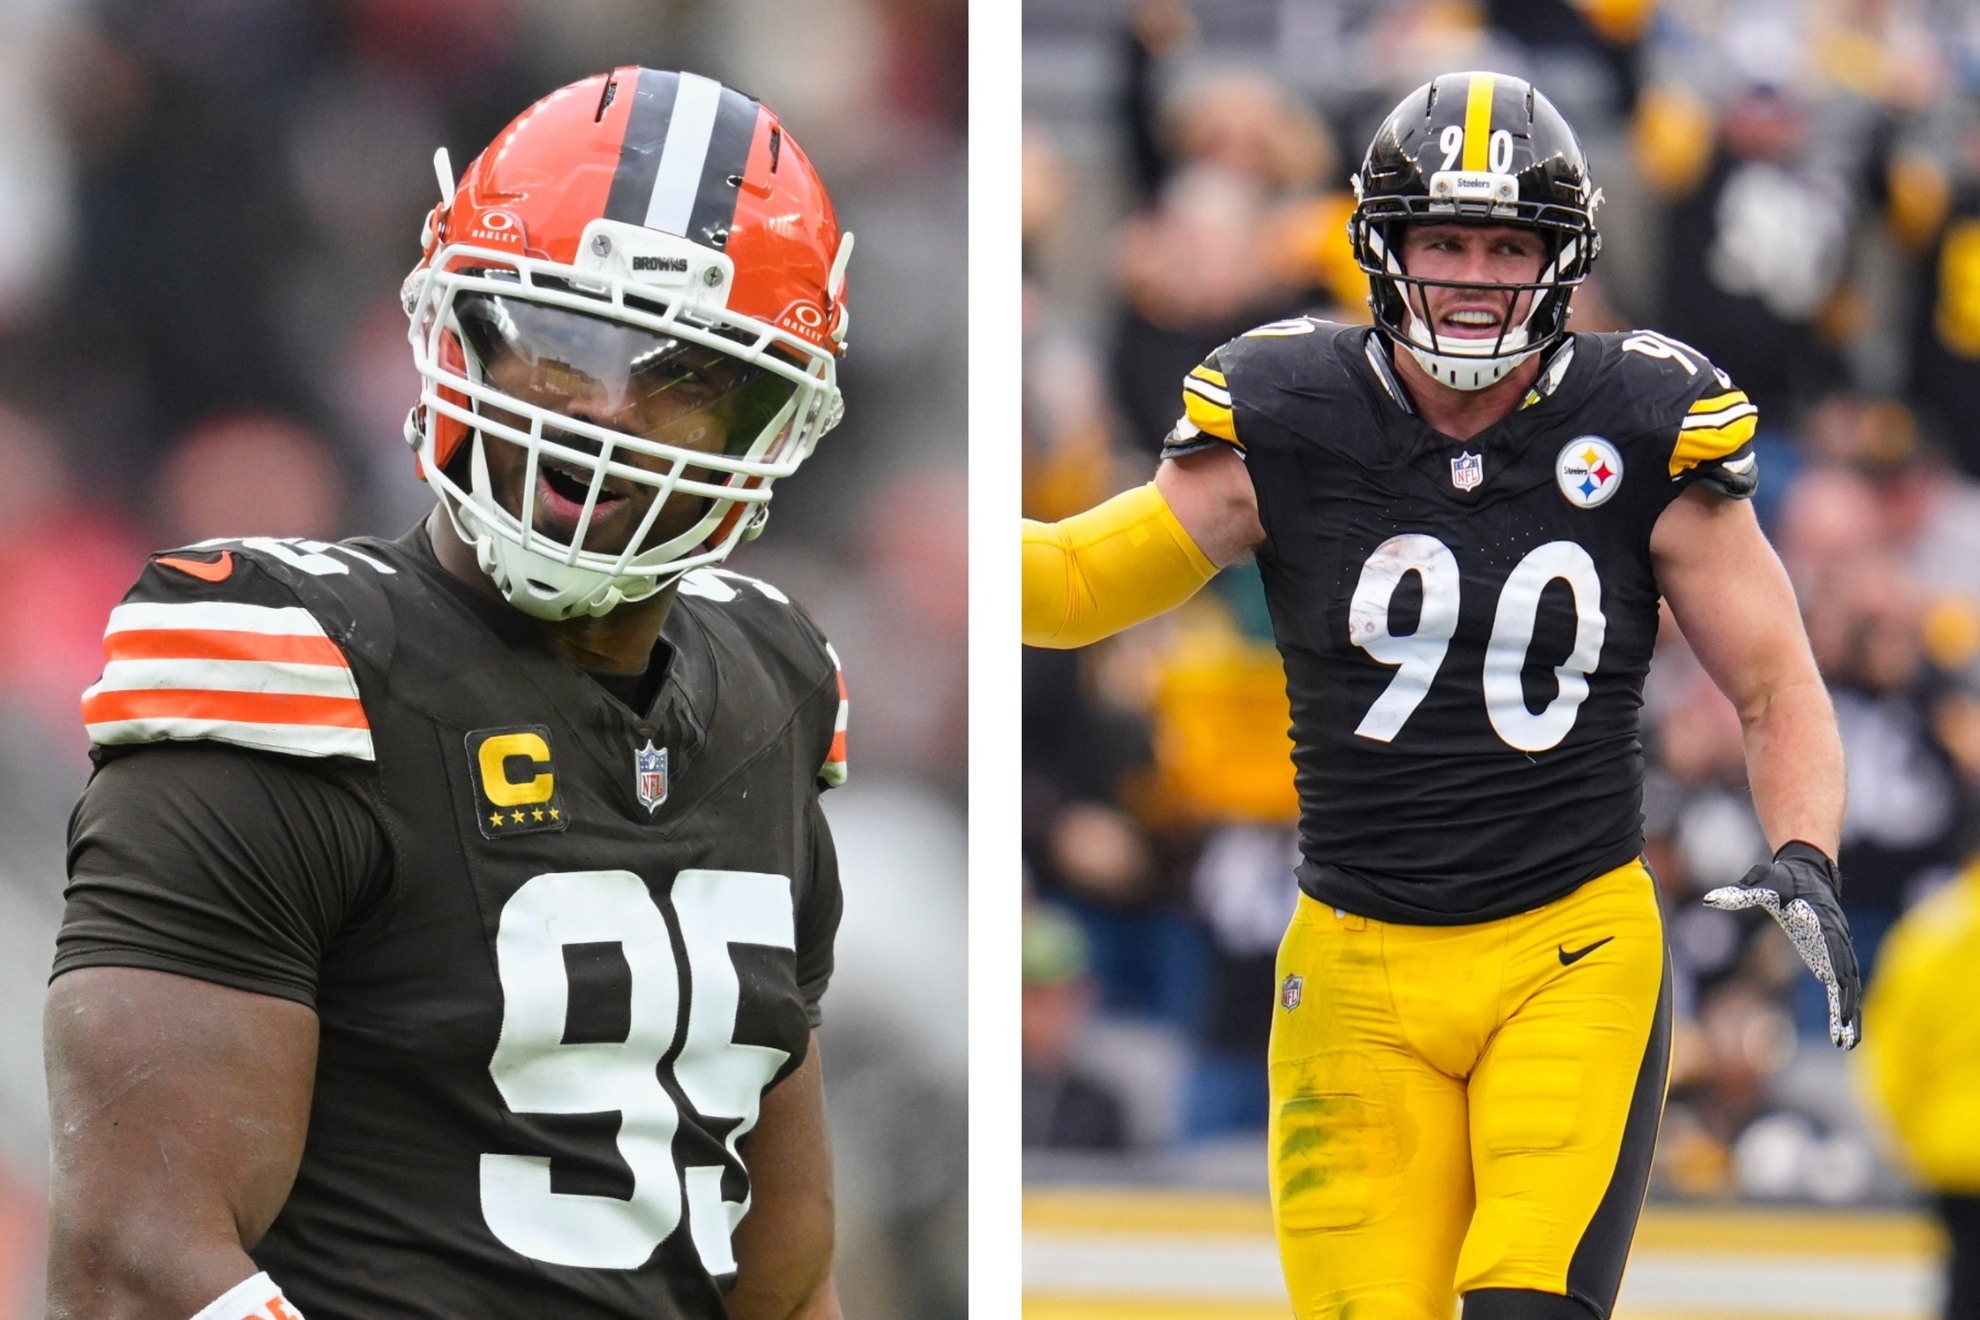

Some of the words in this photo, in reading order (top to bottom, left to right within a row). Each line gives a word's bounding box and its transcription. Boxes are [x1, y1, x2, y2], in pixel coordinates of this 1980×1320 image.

[1457, 178, 1490, 188] Steelers
[472, 229, 518, 244] OAKLEY
[632, 256, 688, 272] BROWNS
[783, 317, 823, 342] OAKLEY
[1563, 466, 1588, 476] Steelers
[1349, 533, 1607, 752] 90
[478, 732, 554, 807] C
[641, 774, 663, 799] NFL
[480, 868, 798, 1277] 95
